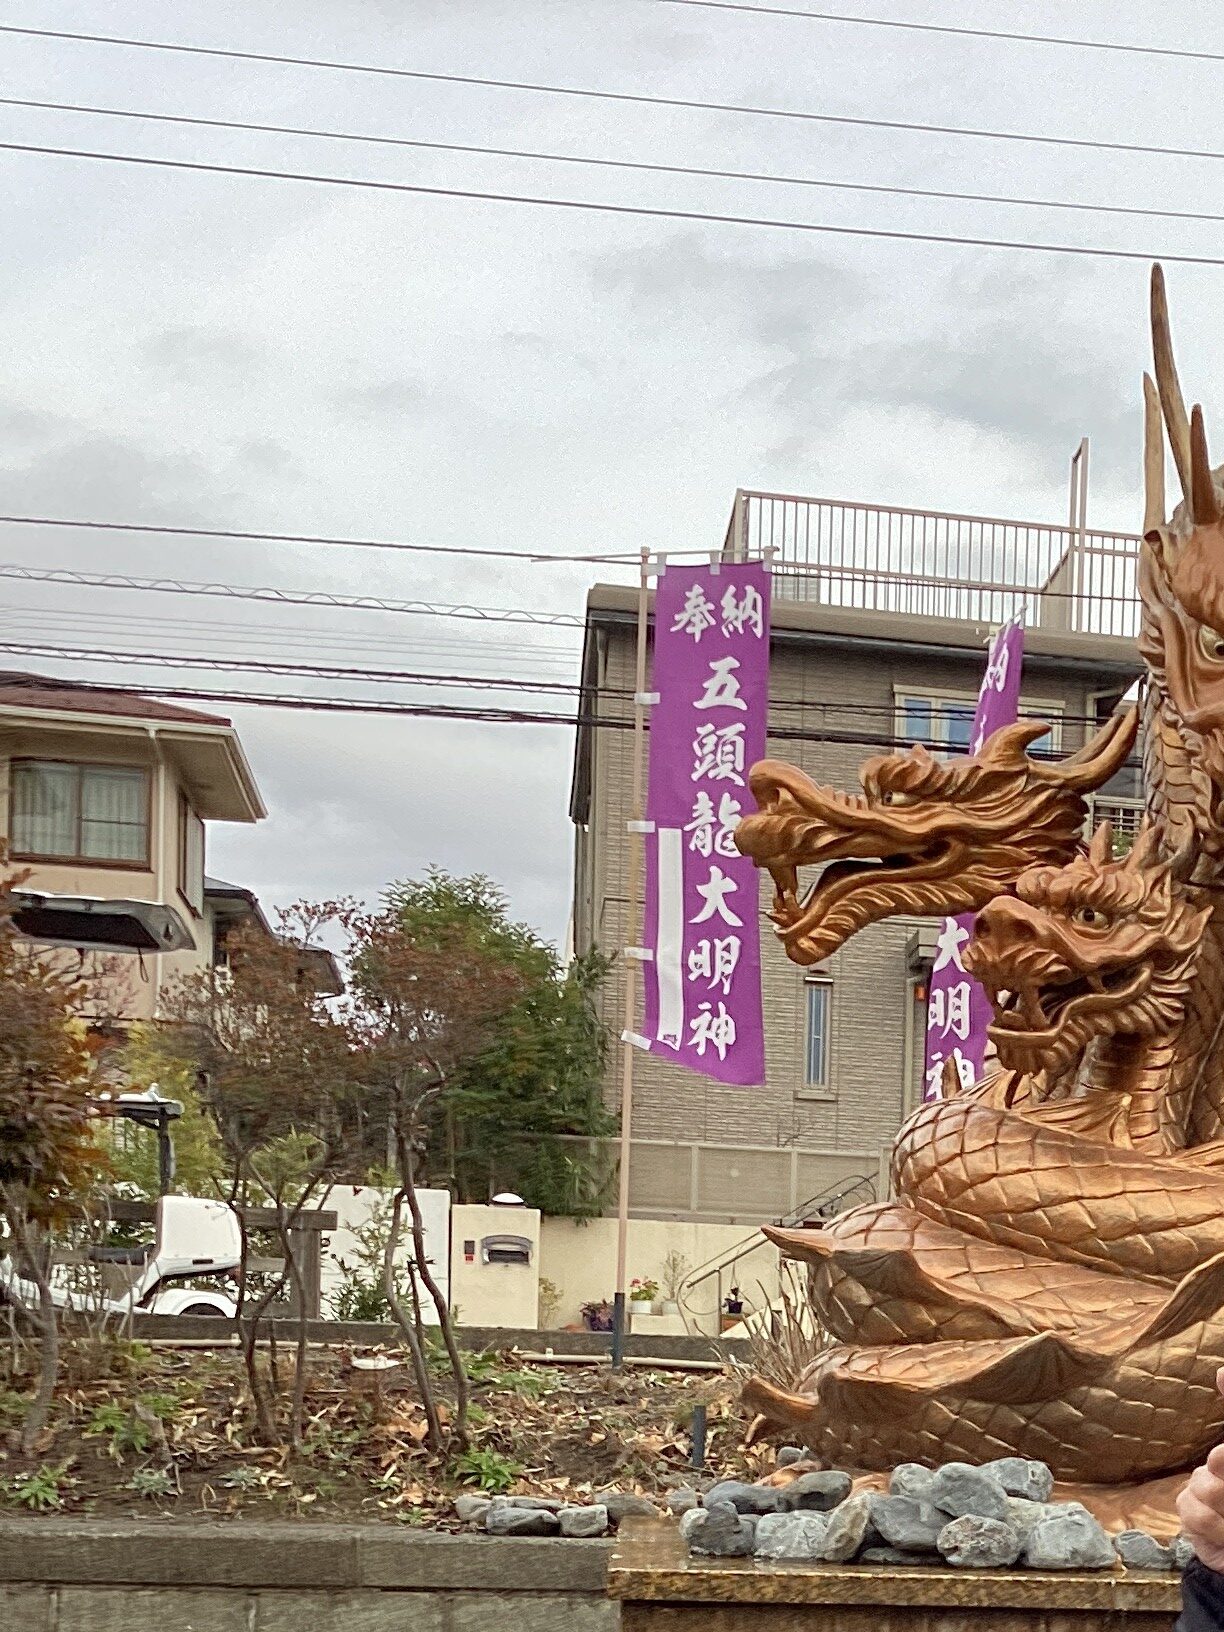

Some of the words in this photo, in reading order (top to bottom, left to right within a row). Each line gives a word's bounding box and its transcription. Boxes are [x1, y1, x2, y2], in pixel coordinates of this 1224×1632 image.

[670, 584, 765, 643] 奉納
[684, 656, 748, 1061] 五頭龍大明神
